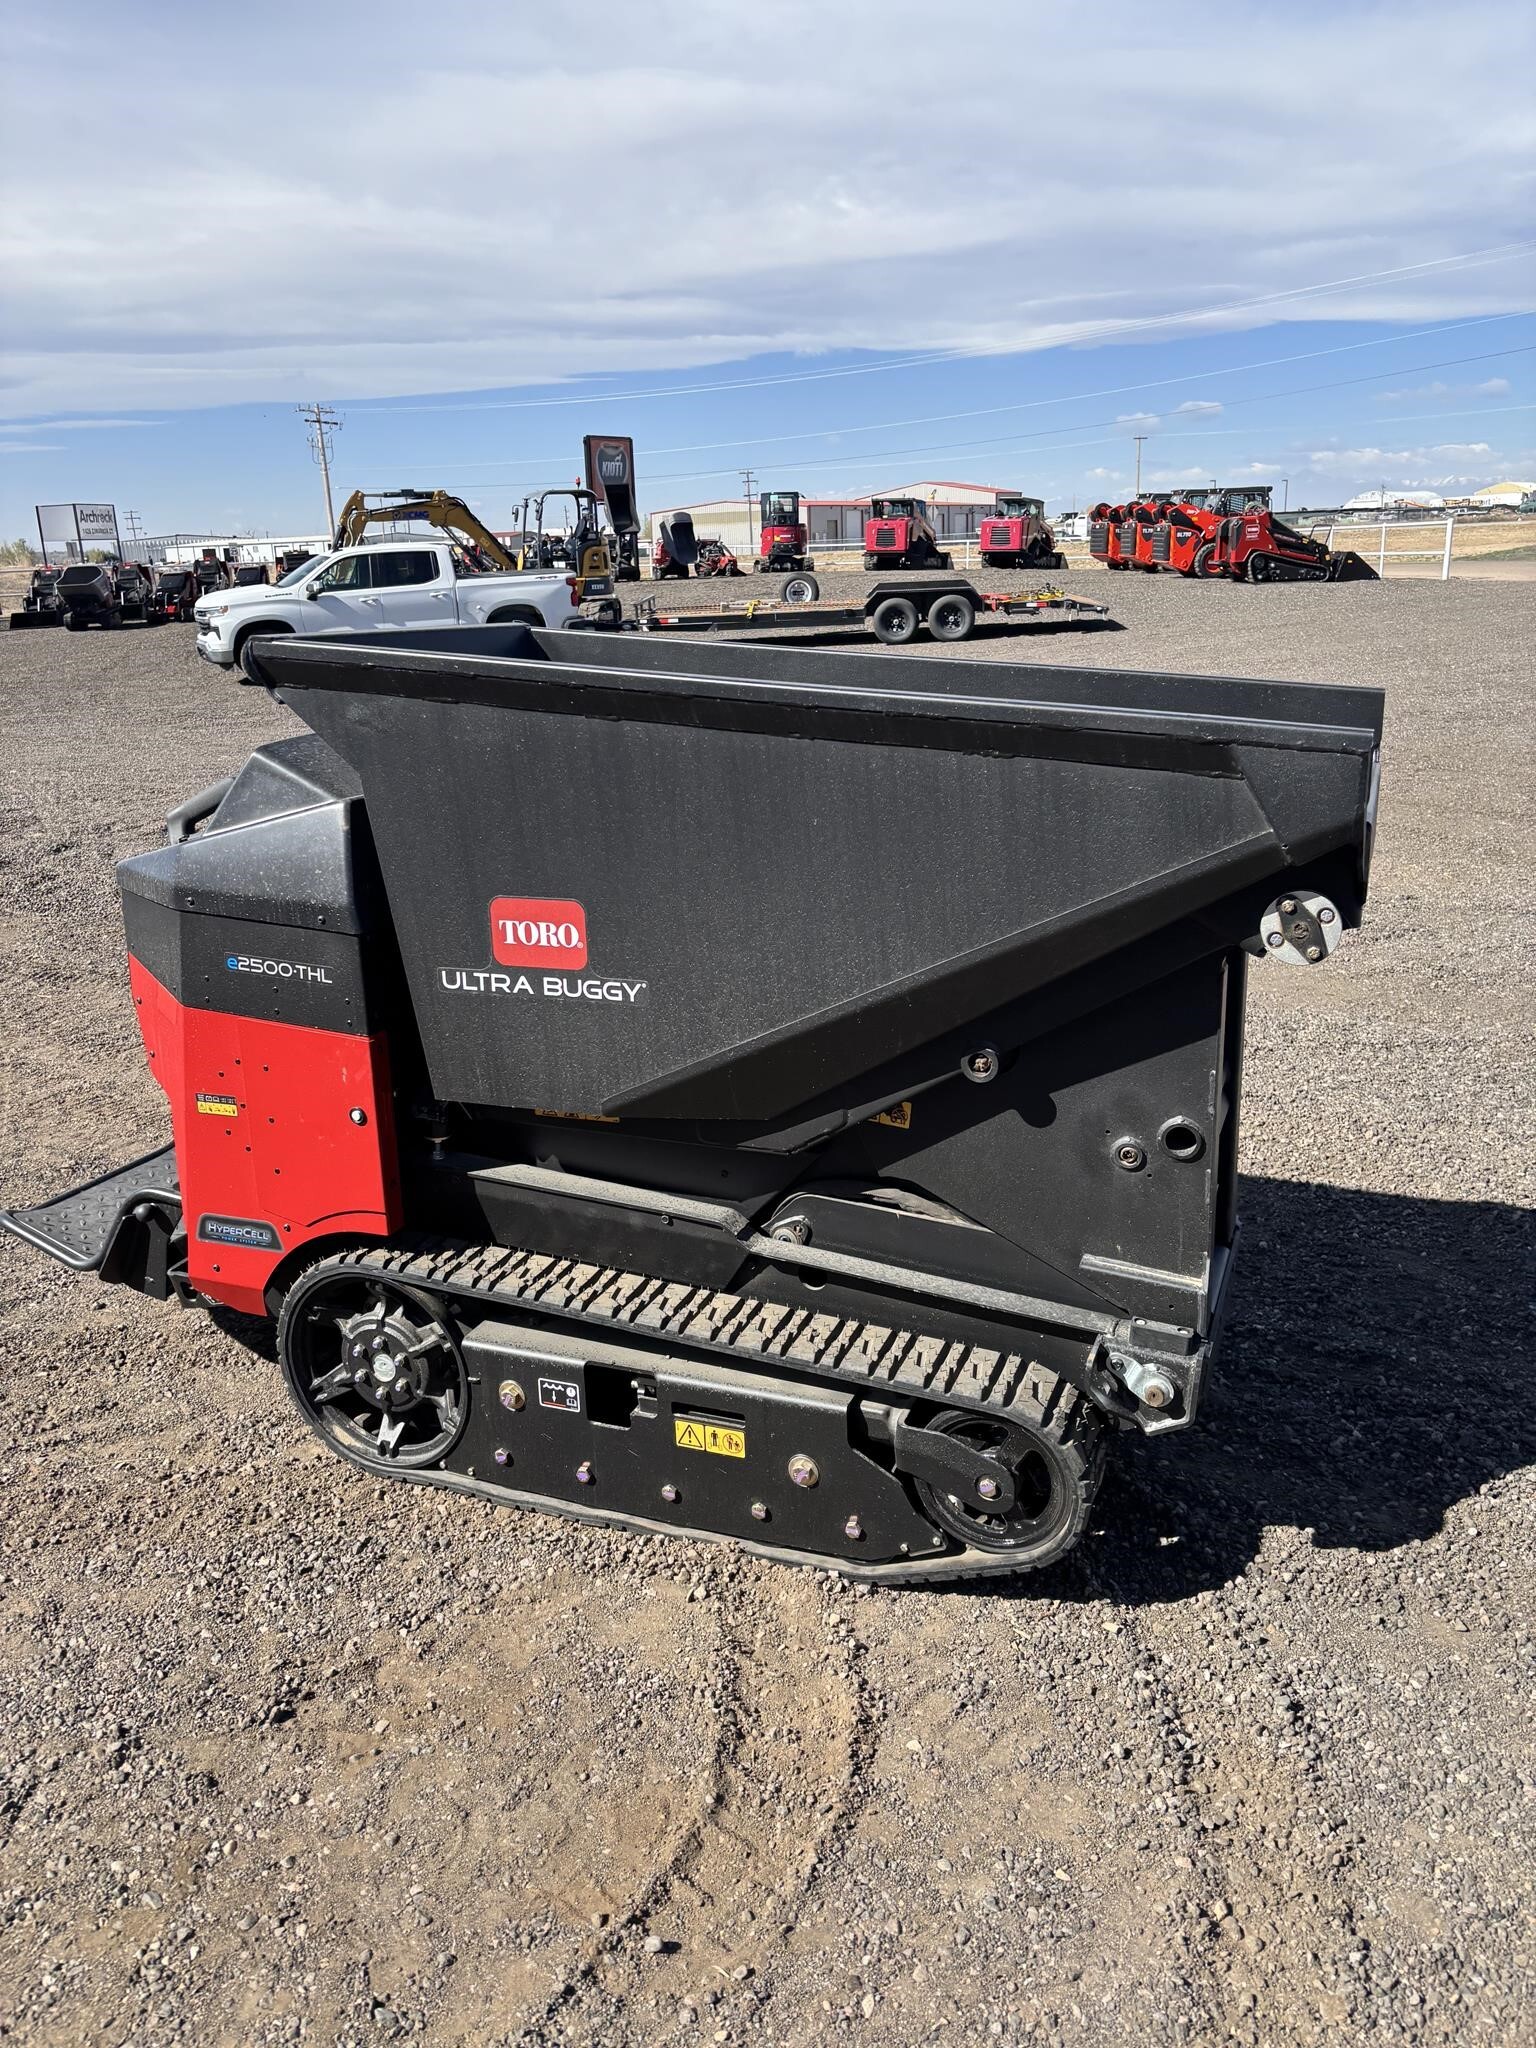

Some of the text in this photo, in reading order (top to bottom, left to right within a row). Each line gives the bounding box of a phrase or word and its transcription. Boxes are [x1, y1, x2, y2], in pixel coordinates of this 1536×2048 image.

[601, 461, 623, 477] KIOTI
[498, 919, 581, 949] TORO
[441, 970, 641, 1002] ULTRA BUGGY
